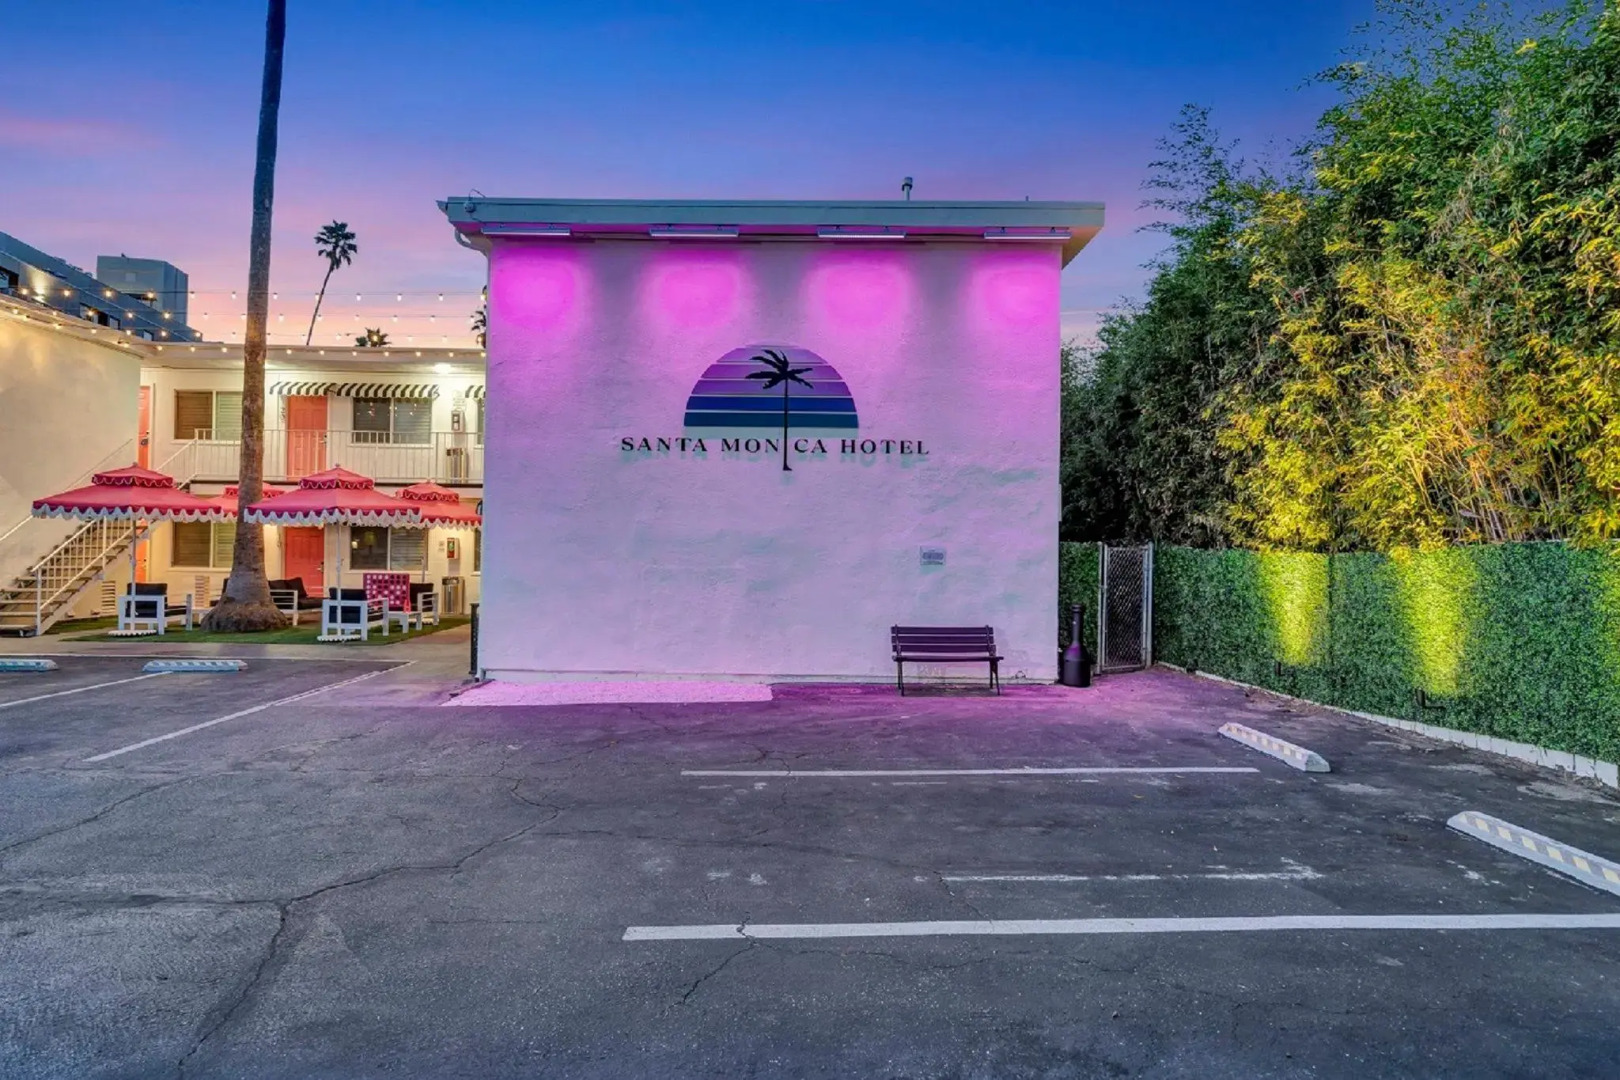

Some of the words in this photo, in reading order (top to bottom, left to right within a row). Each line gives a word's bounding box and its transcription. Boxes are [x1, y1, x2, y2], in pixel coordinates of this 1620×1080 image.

[622, 436, 708, 454] SANTA
[721, 437, 828, 455] MONICA
[841, 438, 930, 456] HOTEL
